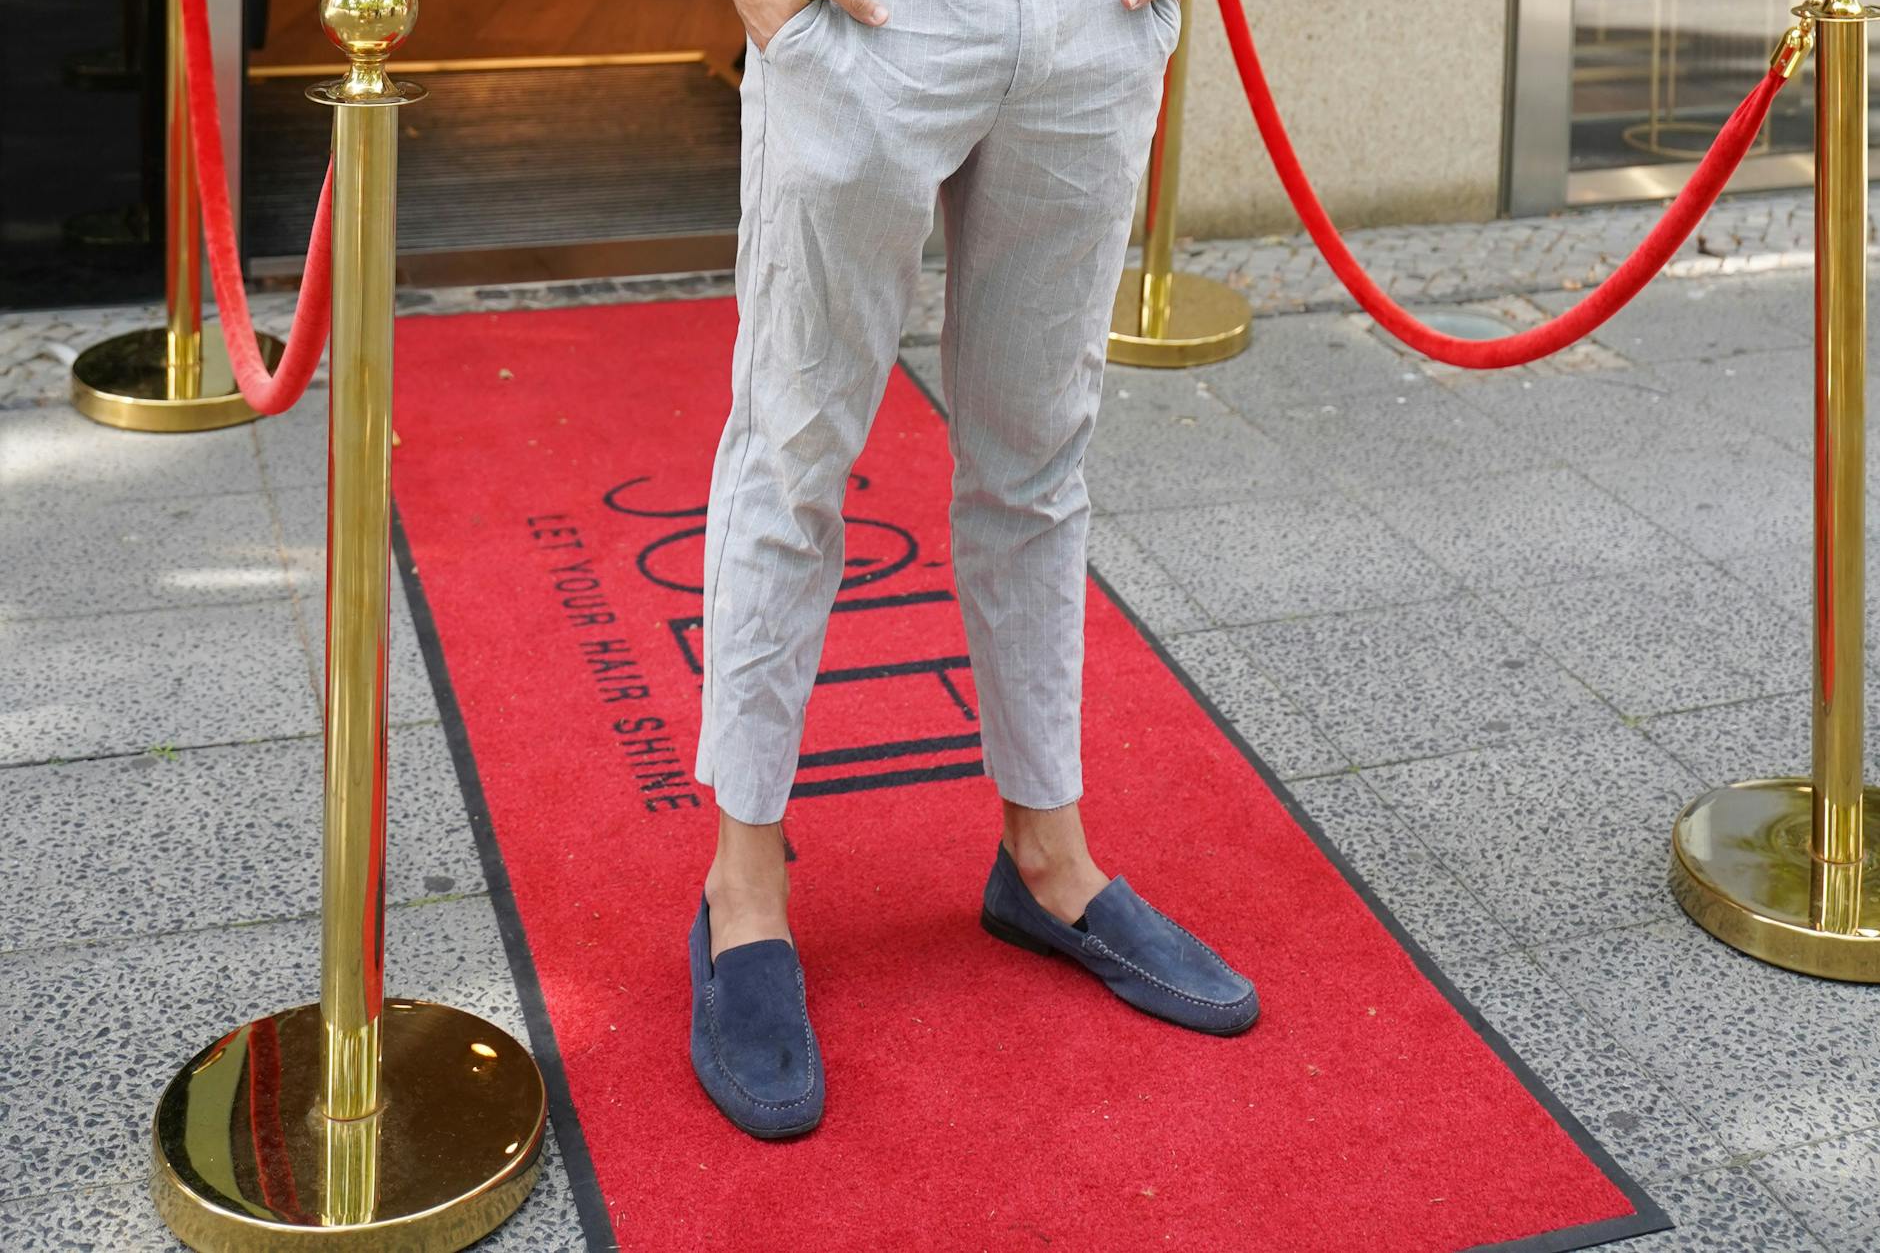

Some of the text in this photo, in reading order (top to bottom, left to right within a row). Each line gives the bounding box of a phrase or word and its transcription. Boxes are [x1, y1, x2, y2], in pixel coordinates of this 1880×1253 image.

[526, 513, 701, 813] LET YOUR HAIR SHINE
